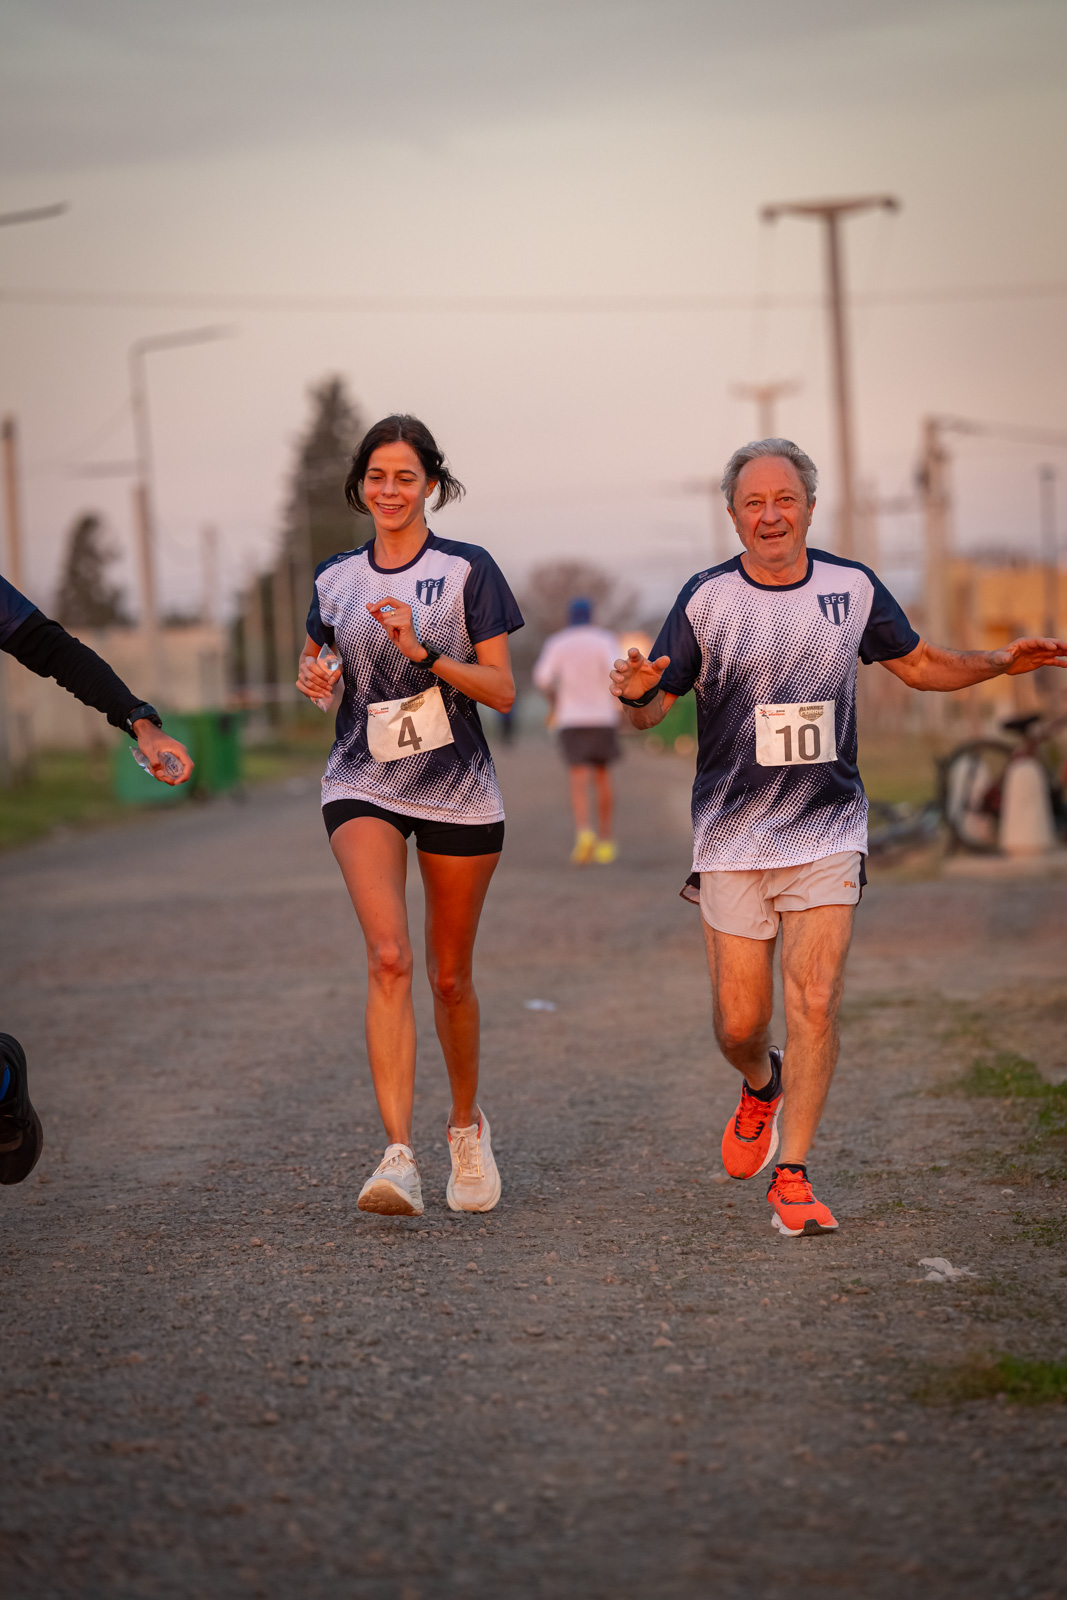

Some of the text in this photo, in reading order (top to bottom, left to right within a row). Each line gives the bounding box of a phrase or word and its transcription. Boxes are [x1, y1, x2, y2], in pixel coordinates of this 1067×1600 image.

[421, 580, 441, 588] SFC
[823, 595, 845, 604] SFC
[397, 715, 423, 751] 4
[775, 723, 821, 762] 10
